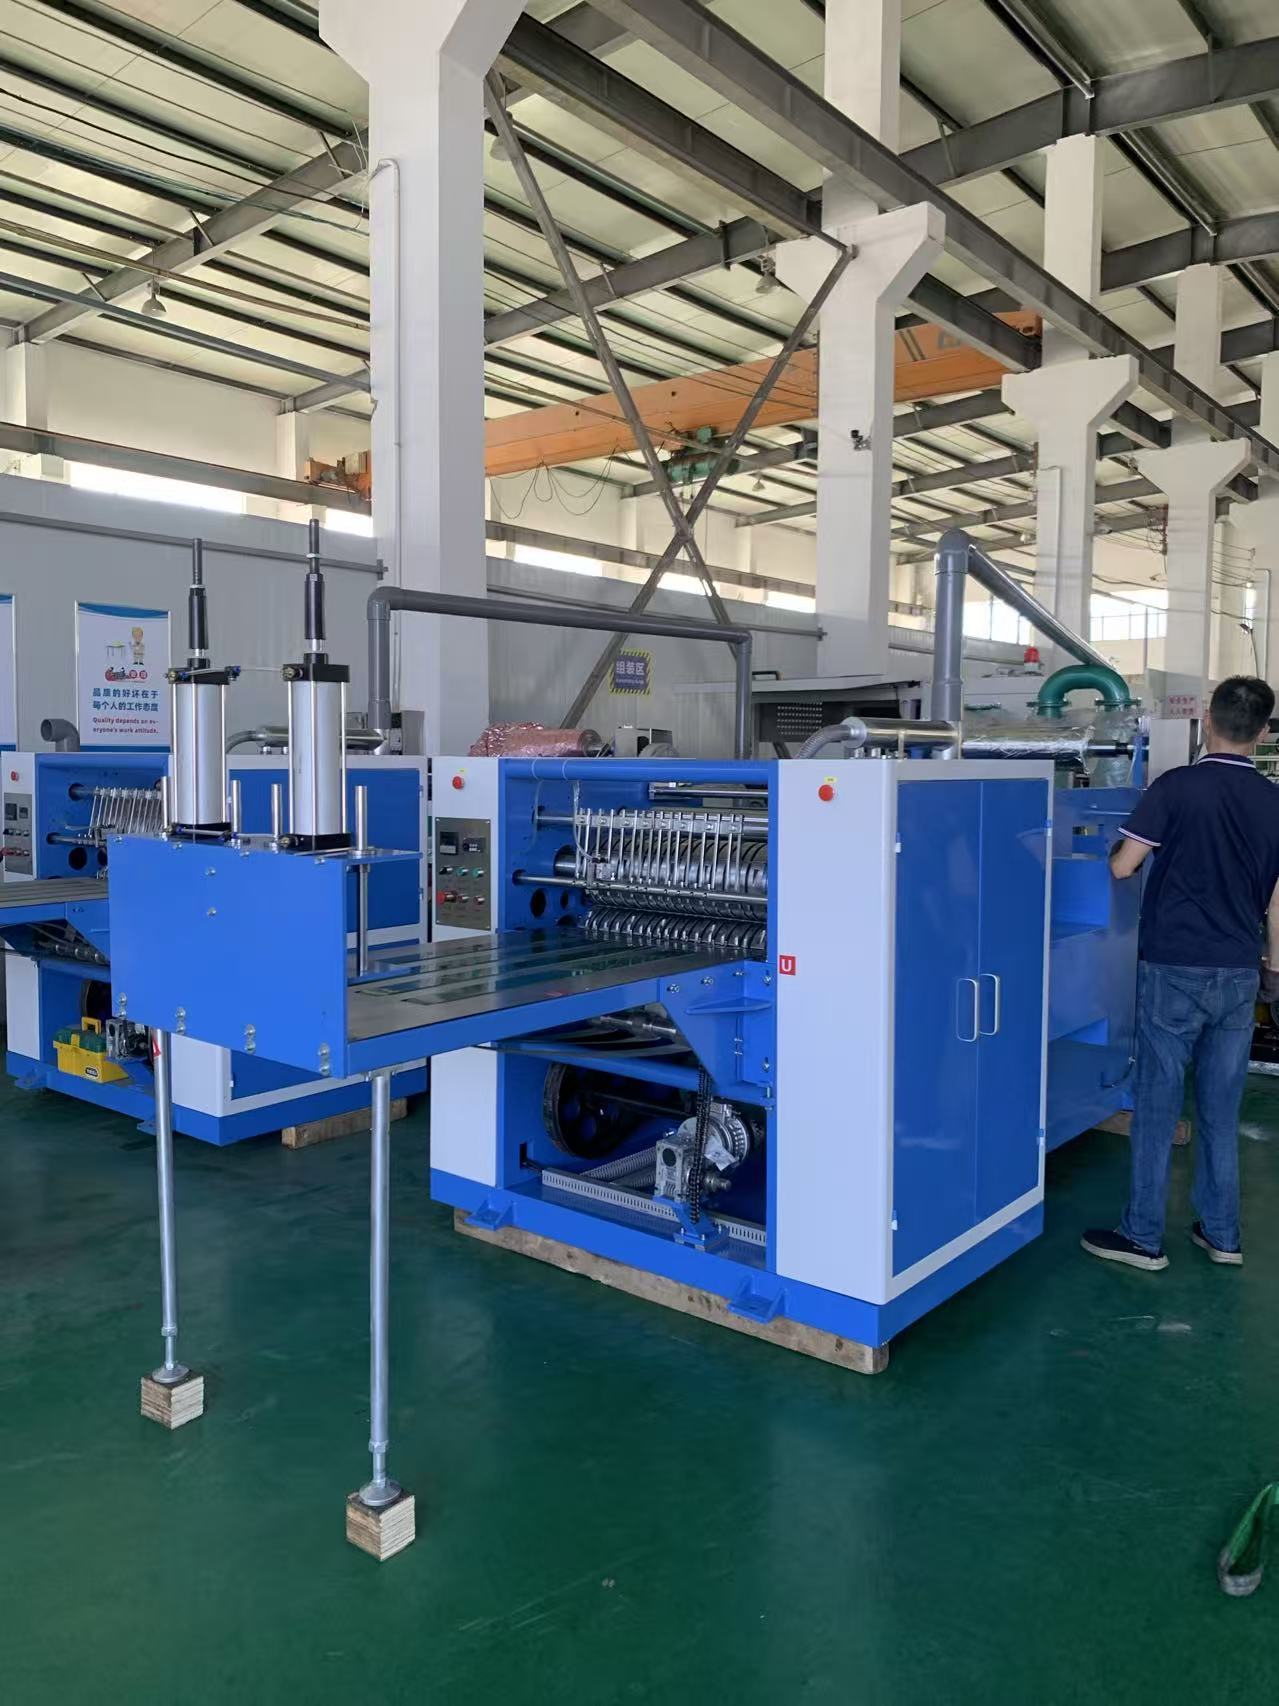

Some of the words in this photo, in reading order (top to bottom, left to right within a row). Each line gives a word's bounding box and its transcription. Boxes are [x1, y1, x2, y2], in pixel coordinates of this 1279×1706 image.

[616, 660, 645, 675] 组装区
[93, 688, 158, 699] 品质的好坏在于
[93, 701, 158, 711] 每个人的工作态度
[93, 717, 114, 725] Quality
[781, 958, 792, 972] U
